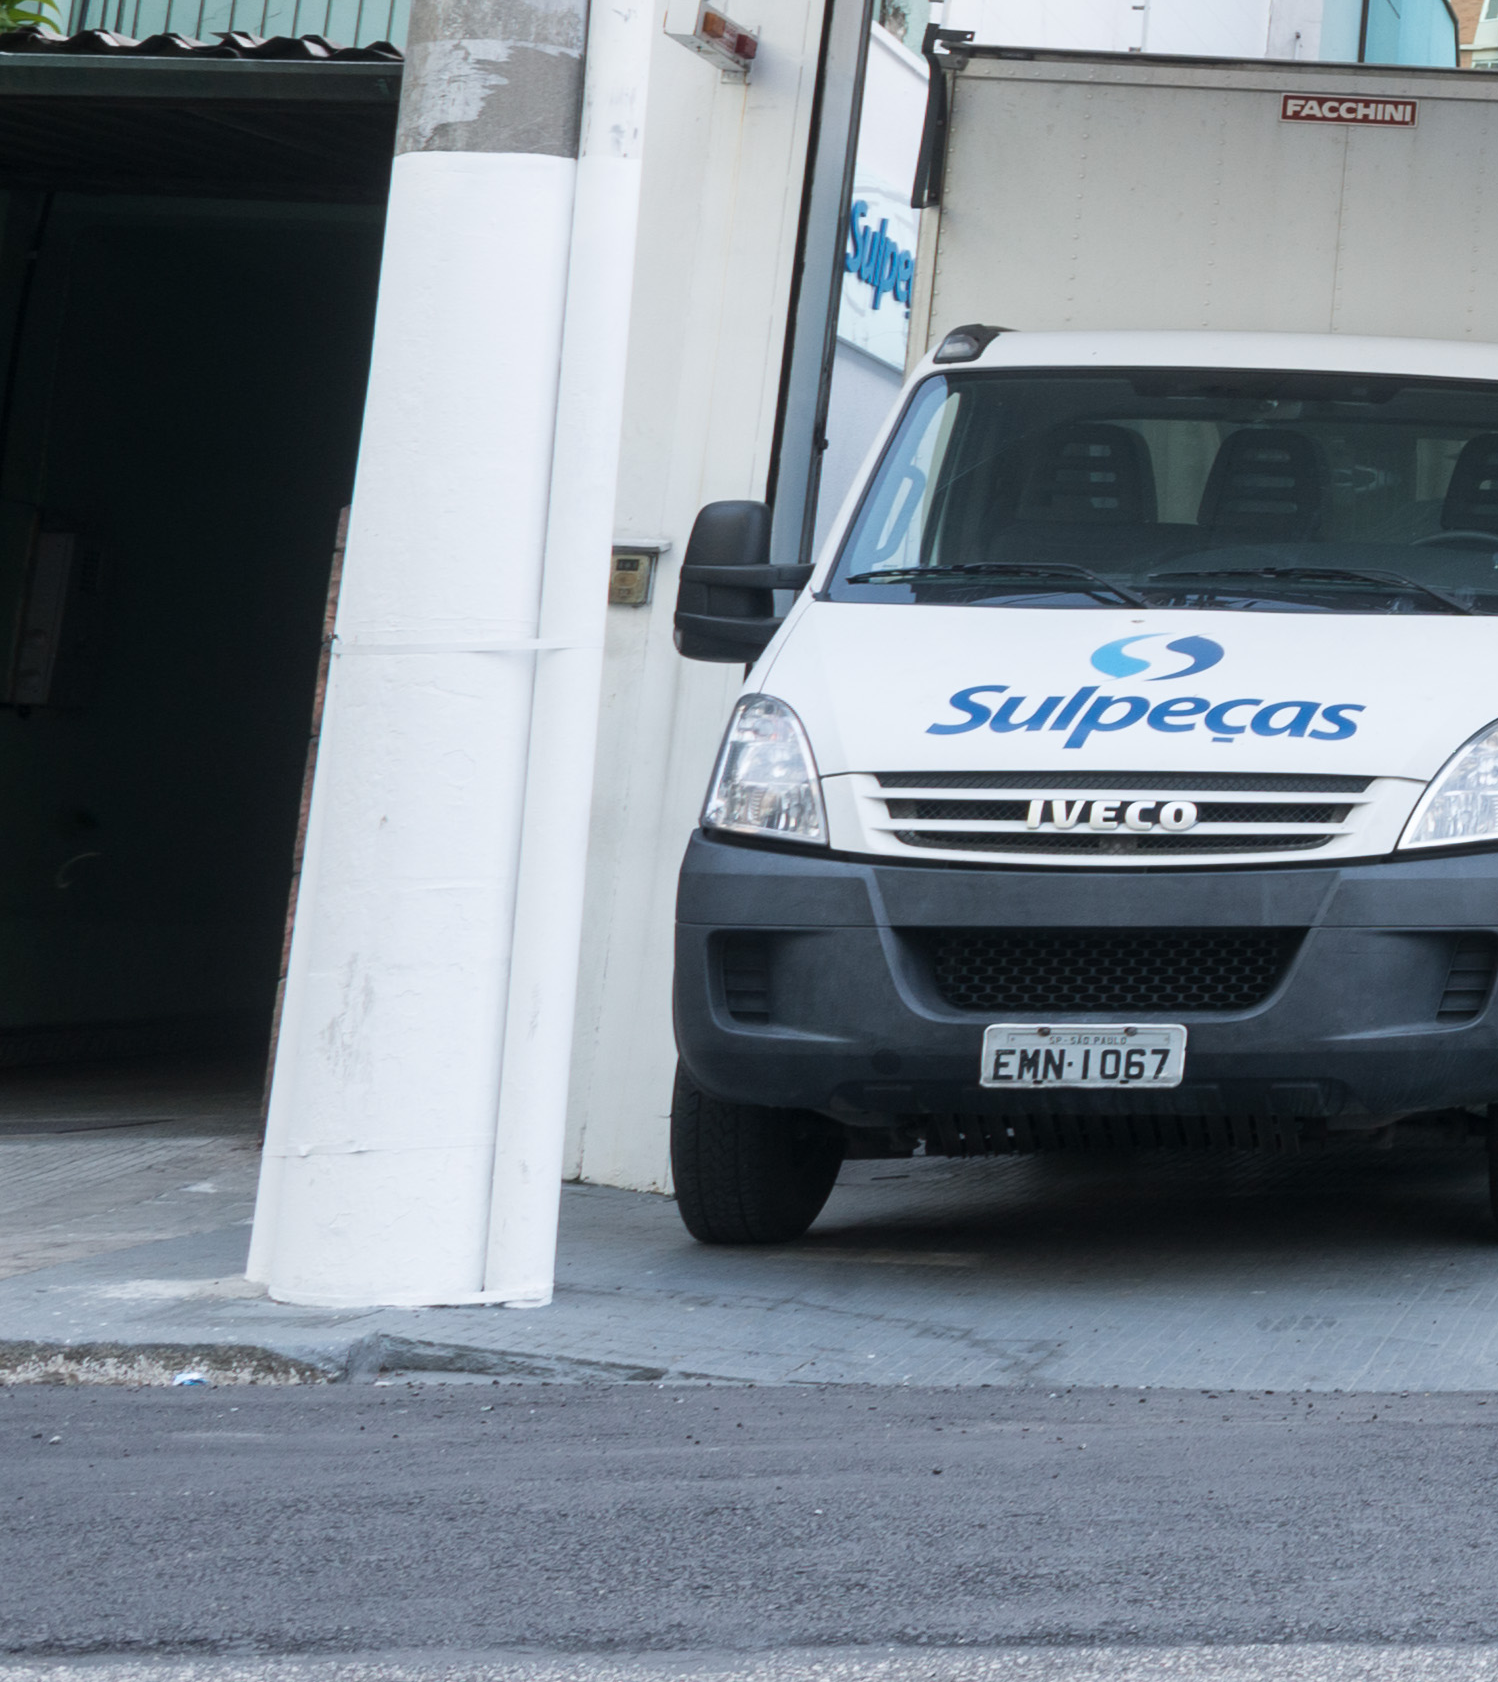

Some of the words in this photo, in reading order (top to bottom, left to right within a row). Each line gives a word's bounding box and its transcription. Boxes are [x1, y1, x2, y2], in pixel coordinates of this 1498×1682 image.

[1286, 100, 1412, 121] FACCHINI
[845, 200, 914, 319] Sulpe
[925, 685, 1366, 749] Sulpeças
[1027, 800, 1198, 831] IVECO
